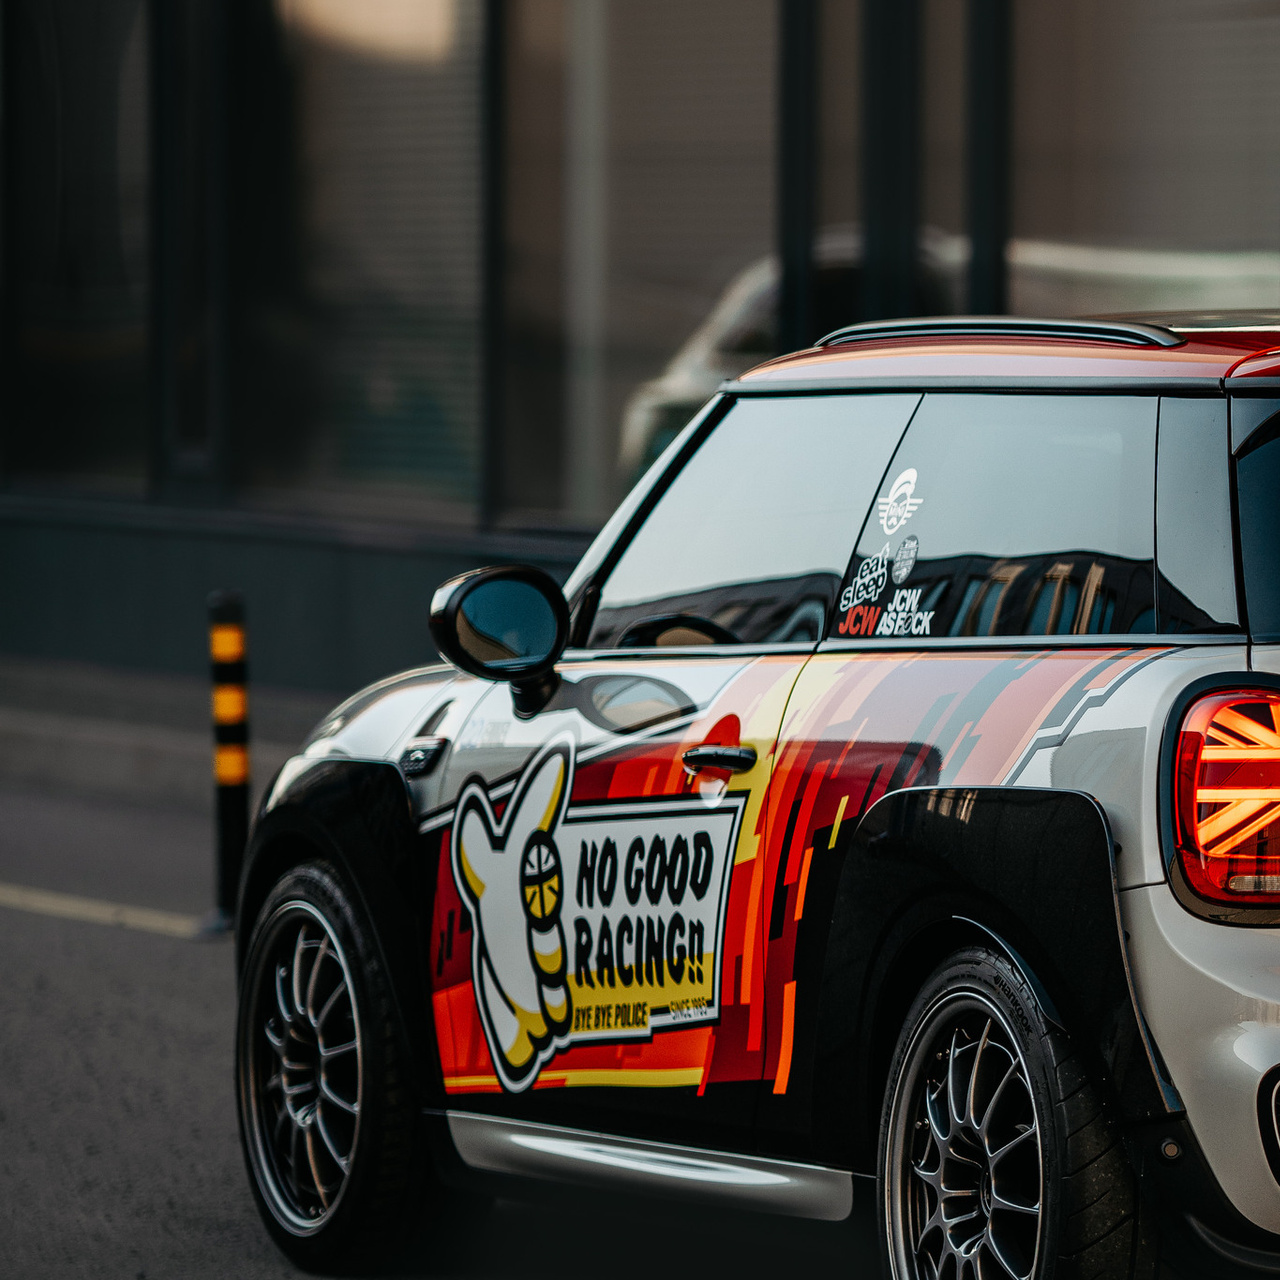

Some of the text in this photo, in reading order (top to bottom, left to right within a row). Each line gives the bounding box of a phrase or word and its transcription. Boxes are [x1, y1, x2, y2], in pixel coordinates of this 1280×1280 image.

[858, 542, 890, 582] eat
[840, 568, 887, 612] sleep
[888, 588, 922, 612] JCW
[838, 605, 881, 636] JCW
[576, 830, 714, 909] NO GOOD
[573, 911, 705, 989] RACING!!
[574, 1001, 648, 1031] BYE BYE POLICE
